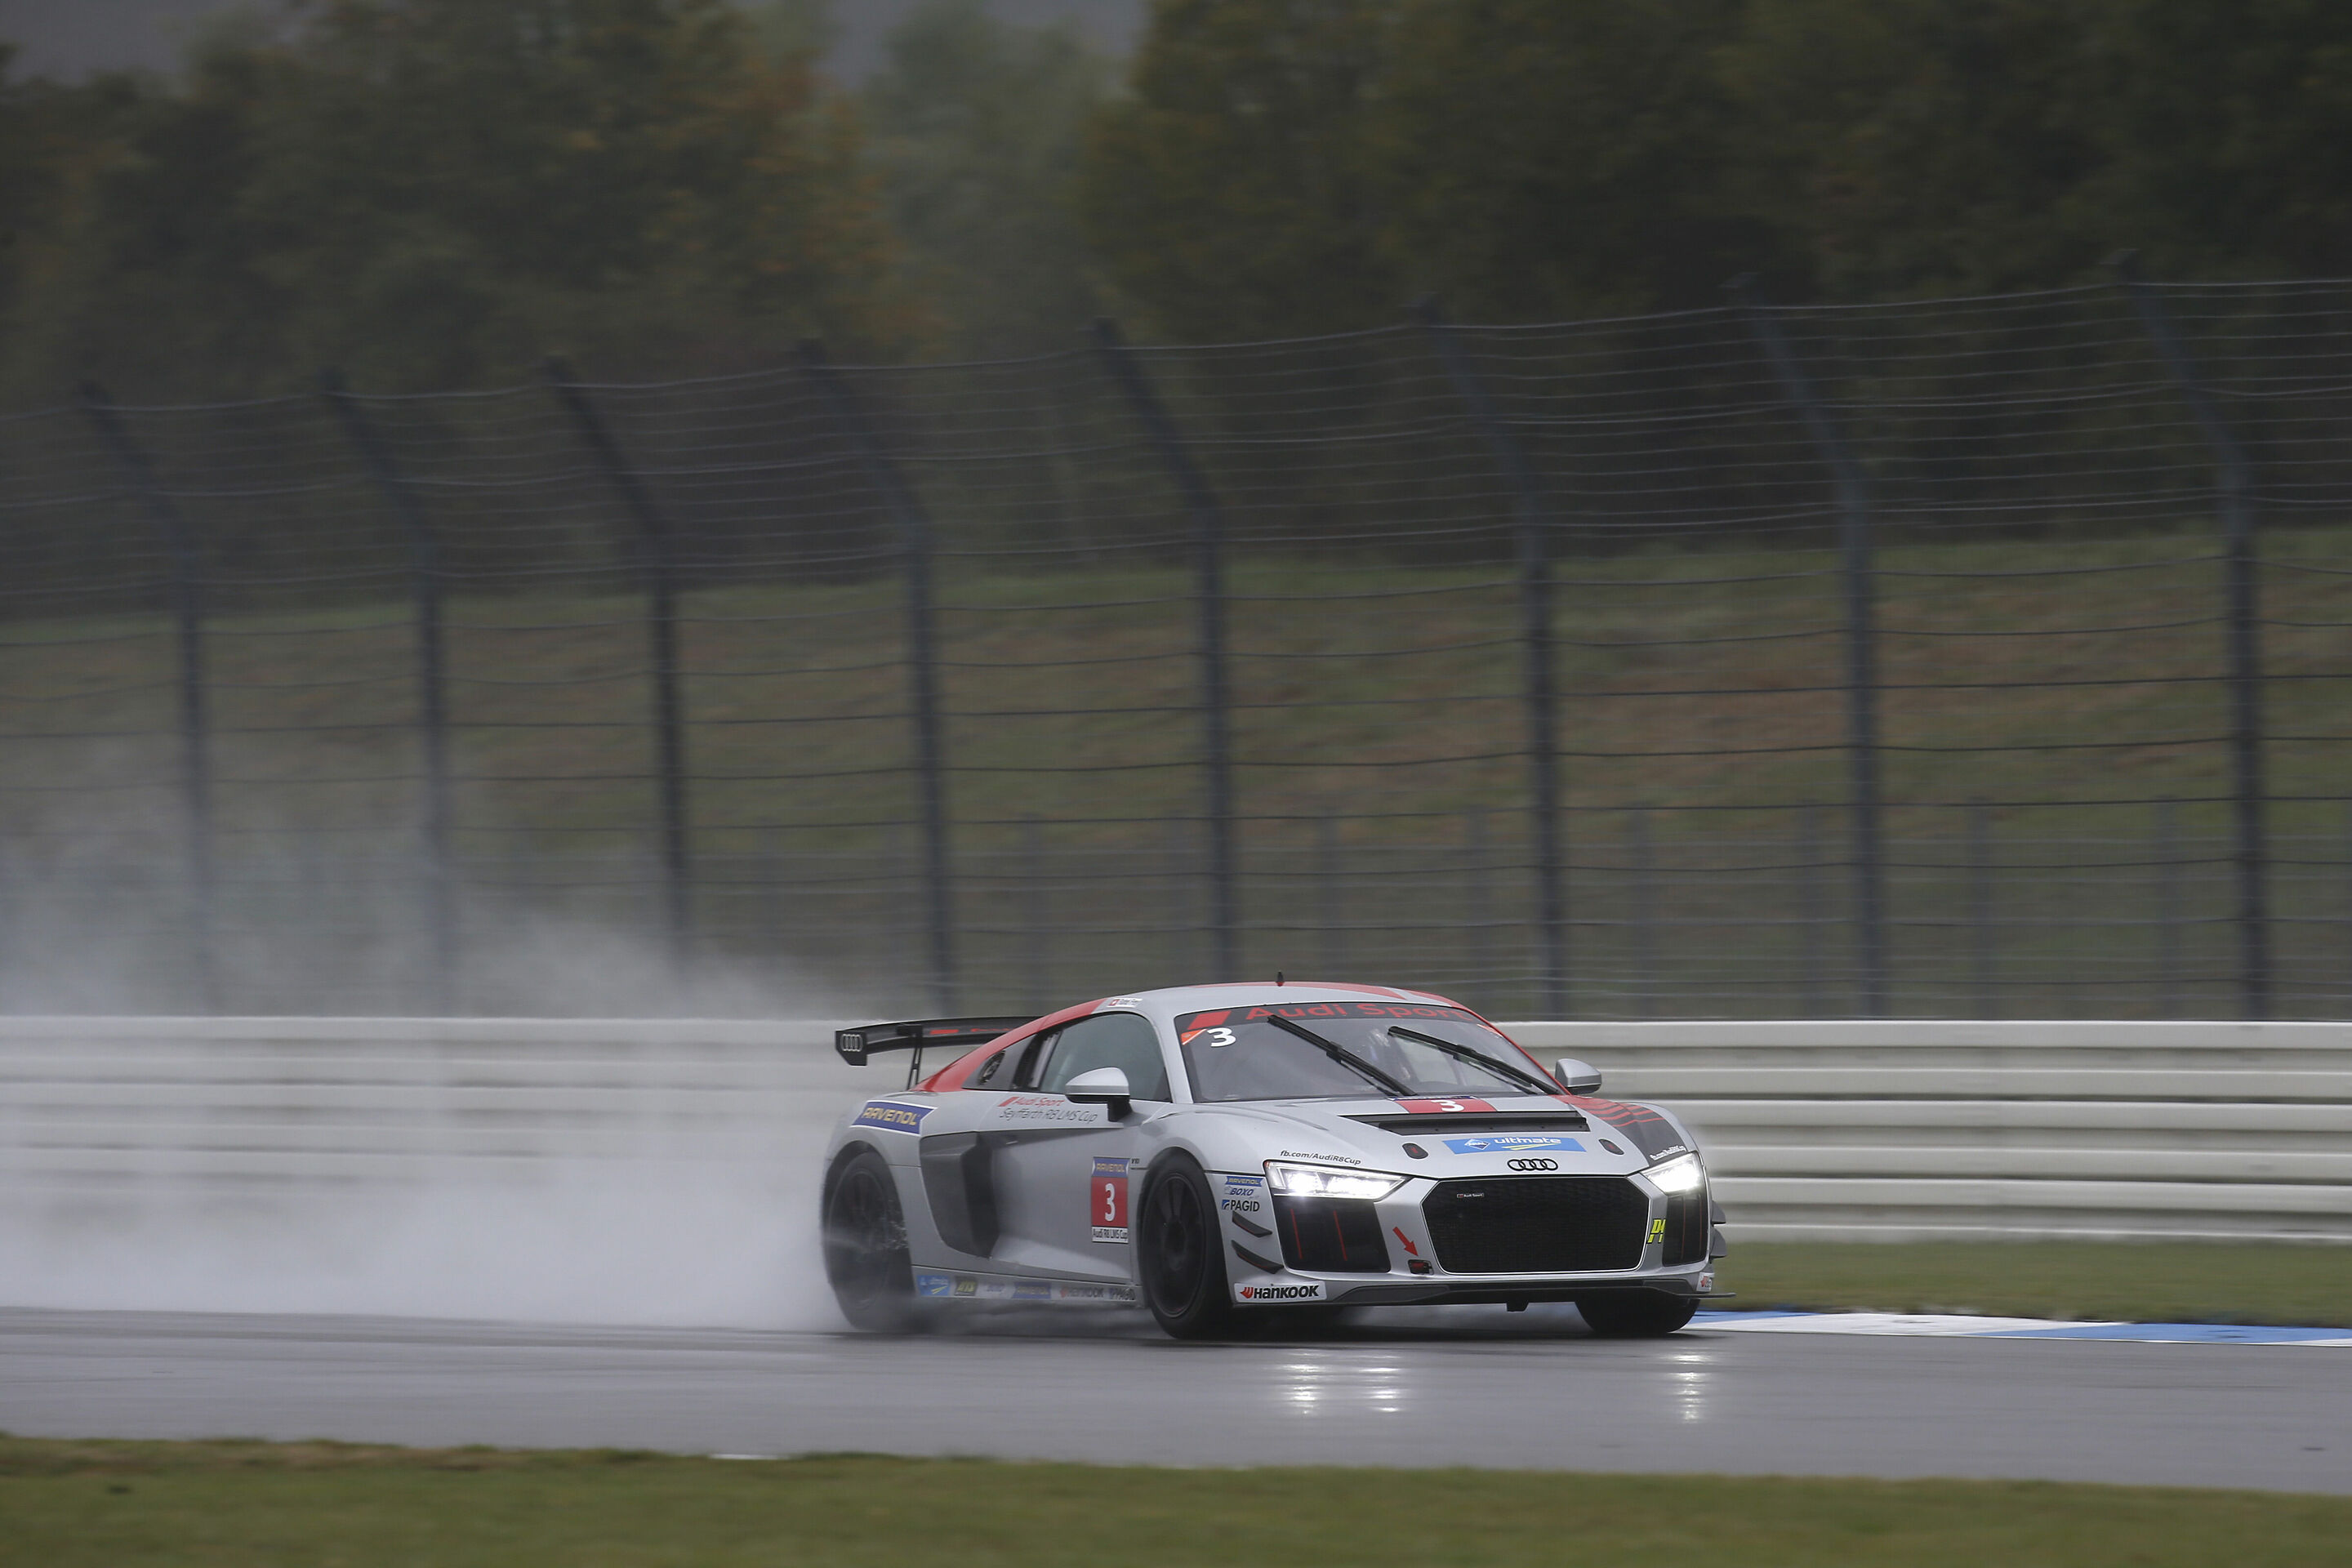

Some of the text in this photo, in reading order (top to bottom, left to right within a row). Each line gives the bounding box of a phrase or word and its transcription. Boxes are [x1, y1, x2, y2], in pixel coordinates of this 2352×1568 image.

[1245, 1003, 1473, 1022] Audi Sport
[1206, 1027, 1237, 1048] 3
[1430, 1099, 1465, 1112] 3
[861, 1107, 919, 1126] RAVENOL
[1077, 1111, 1098, 1124] Cup
[1280, 1150, 1361, 1165] fb.com/AudiR8Cup
[1230, 1187, 1254, 1196] BOXO
[1104, 1183, 1116, 1222] 3
[1230, 1200, 1260, 1212] PAGID
